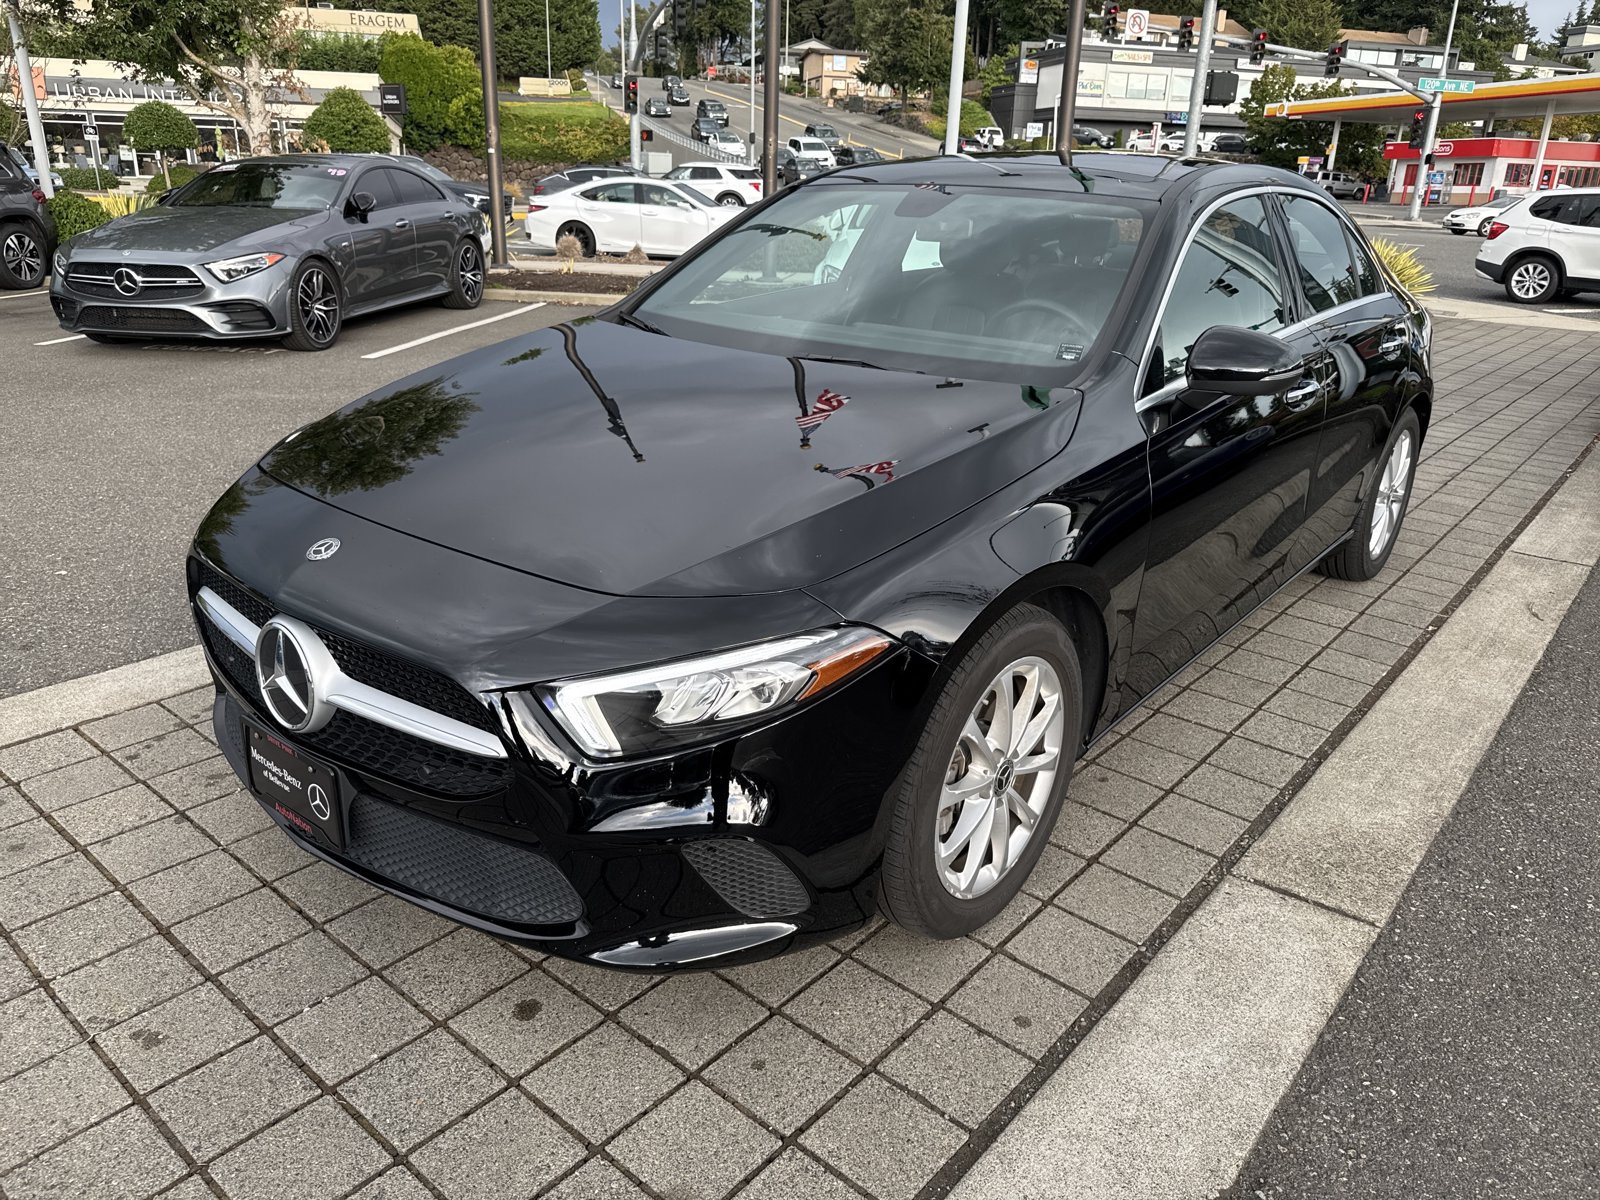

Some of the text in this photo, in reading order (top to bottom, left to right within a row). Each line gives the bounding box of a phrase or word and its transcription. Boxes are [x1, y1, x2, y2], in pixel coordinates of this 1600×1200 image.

[350, 12, 406, 28] ERAGEM
[53, 82, 134, 103] URBAN
[1443, 81, 1456, 90] Ave
[1459, 81, 1469, 91] NE
[250, 746, 303, 790] Mercedes-Benz
[275, 802, 313, 834] AutoNation
